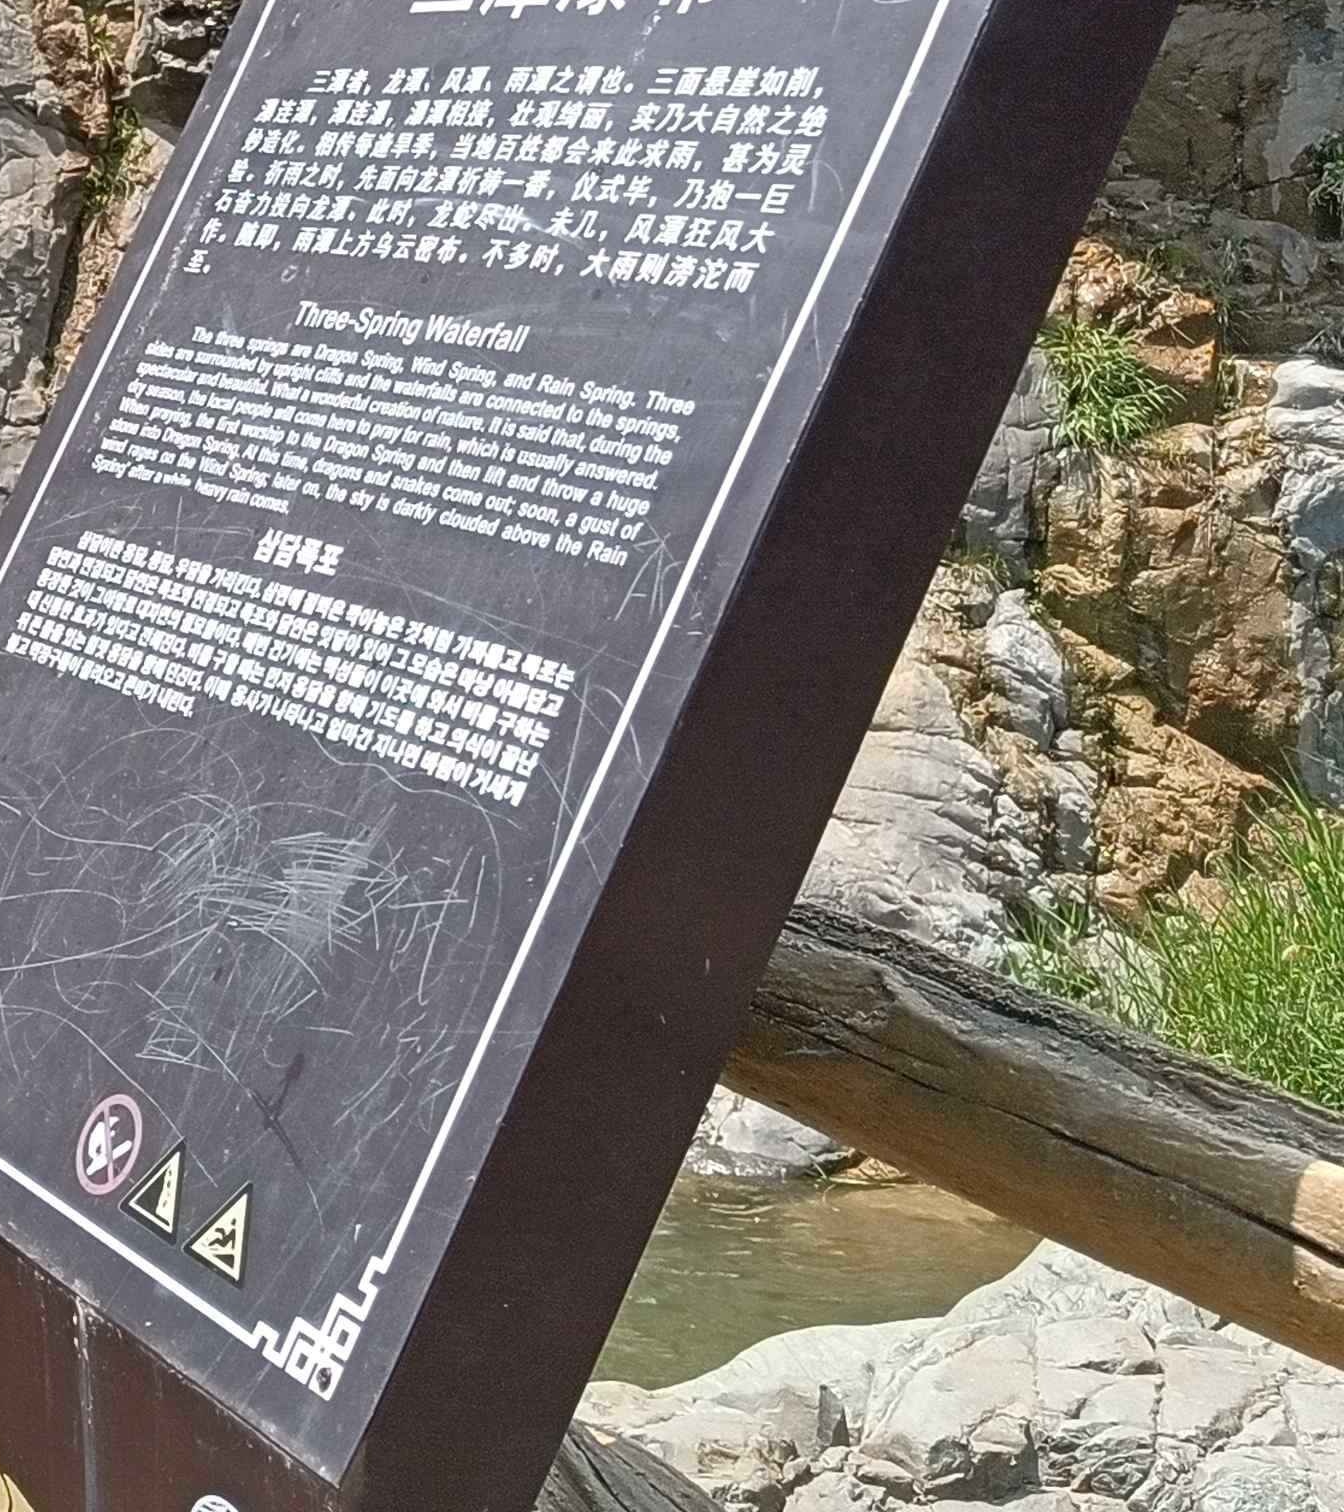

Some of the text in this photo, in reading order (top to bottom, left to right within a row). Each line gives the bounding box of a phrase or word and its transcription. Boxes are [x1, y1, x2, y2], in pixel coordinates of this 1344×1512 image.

[184, 249, 210, 273] 至。
[296, 300, 530, 352] Three-Spring Waterfall
[273, 362, 315, 382] upright
[315, 366, 344, 384] cliffs
[344, 372, 371, 388] and
[370, 374, 391, 391] the
[393, 380, 457, 401] waterfalls
[459, 390, 483, 406] are
[486, 394, 566, 419] connected
[567, 403, 583, 422] to
[586, 407, 613, 427] the
[616, 416, 680, 442] springs,
[291, 343, 312, 357] are
[314, 343, 358, 365] Dragon
[412, 356, 447, 376] Wind
[449, 361, 496, 388] Spring,
[504, 372, 536, 389] and
[537, 374, 575, 396] Rain
[580, 380, 635, 409] Spring.
[647, 390, 695, 415] Three
[271, 381, 302, 399] What
[300, 388, 310, 401] a
[311, 391, 371, 410] wonderful
[369, 400, 421, 419] creation
[422, 405, 441, 422] of
[437, 410, 484, 432] nature.
[489, 415, 502, 433] It
[501, 417, 516, 436] is
[517, 423, 552, 442] said
[551, 428, 586, 452] that,
[590, 434, 642, 462] during
[644, 444, 672, 464] the
[295, 411, 327, 427] come
[327, 413, 356, 432] here
[357, 418, 371, 434] to
[369, 423, 403, 444] pray
[402, 425, 423, 443] for
[422, 431, 451, 452] rain,
[457, 436, 499, 458] which
[501, 443, 515, 461] is
[517, 450, 574, 476] usually
[575, 461, 658, 489] answered.
[286, 429, 299, 445] to
[301, 431, 321, 449] the
[323, 435, 369, 459] Dragon
[372, 443, 416, 471] Spring
[418, 456, 447, 473] and
[448, 459, 481, 480] then
[483, 465, 505, 486] lift
[508, 474, 540, 492] and
[542, 477, 588, 502] throw
[590, 490, 603, 505] a
[607, 489, 649, 515] huge
[313, 457, 363, 480] dragons
[364, 470, 392, 486] and
[391, 475, 440, 497] snakes
[443, 486, 482, 505] come
[486, 495, 516, 515] out;
[518, 502, 559, 526] soon,
[566, 512, 577, 526] a
[579, 513, 626, 536] gust
[621, 514, 643, 540] of
[254, 527, 343, 575] 삼담폭포
[272, 471, 301, 490] later
[326, 483, 347, 501] the
[350, 489, 374, 511] sky
[376, 493, 389, 511] is
[393, 497, 437, 524] darkly
[440, 508, 500, 535] clouded
[502, 523, 550, 547] above
[556, 531, 586, 555] the
[588, 540, 627, 566] Rain
